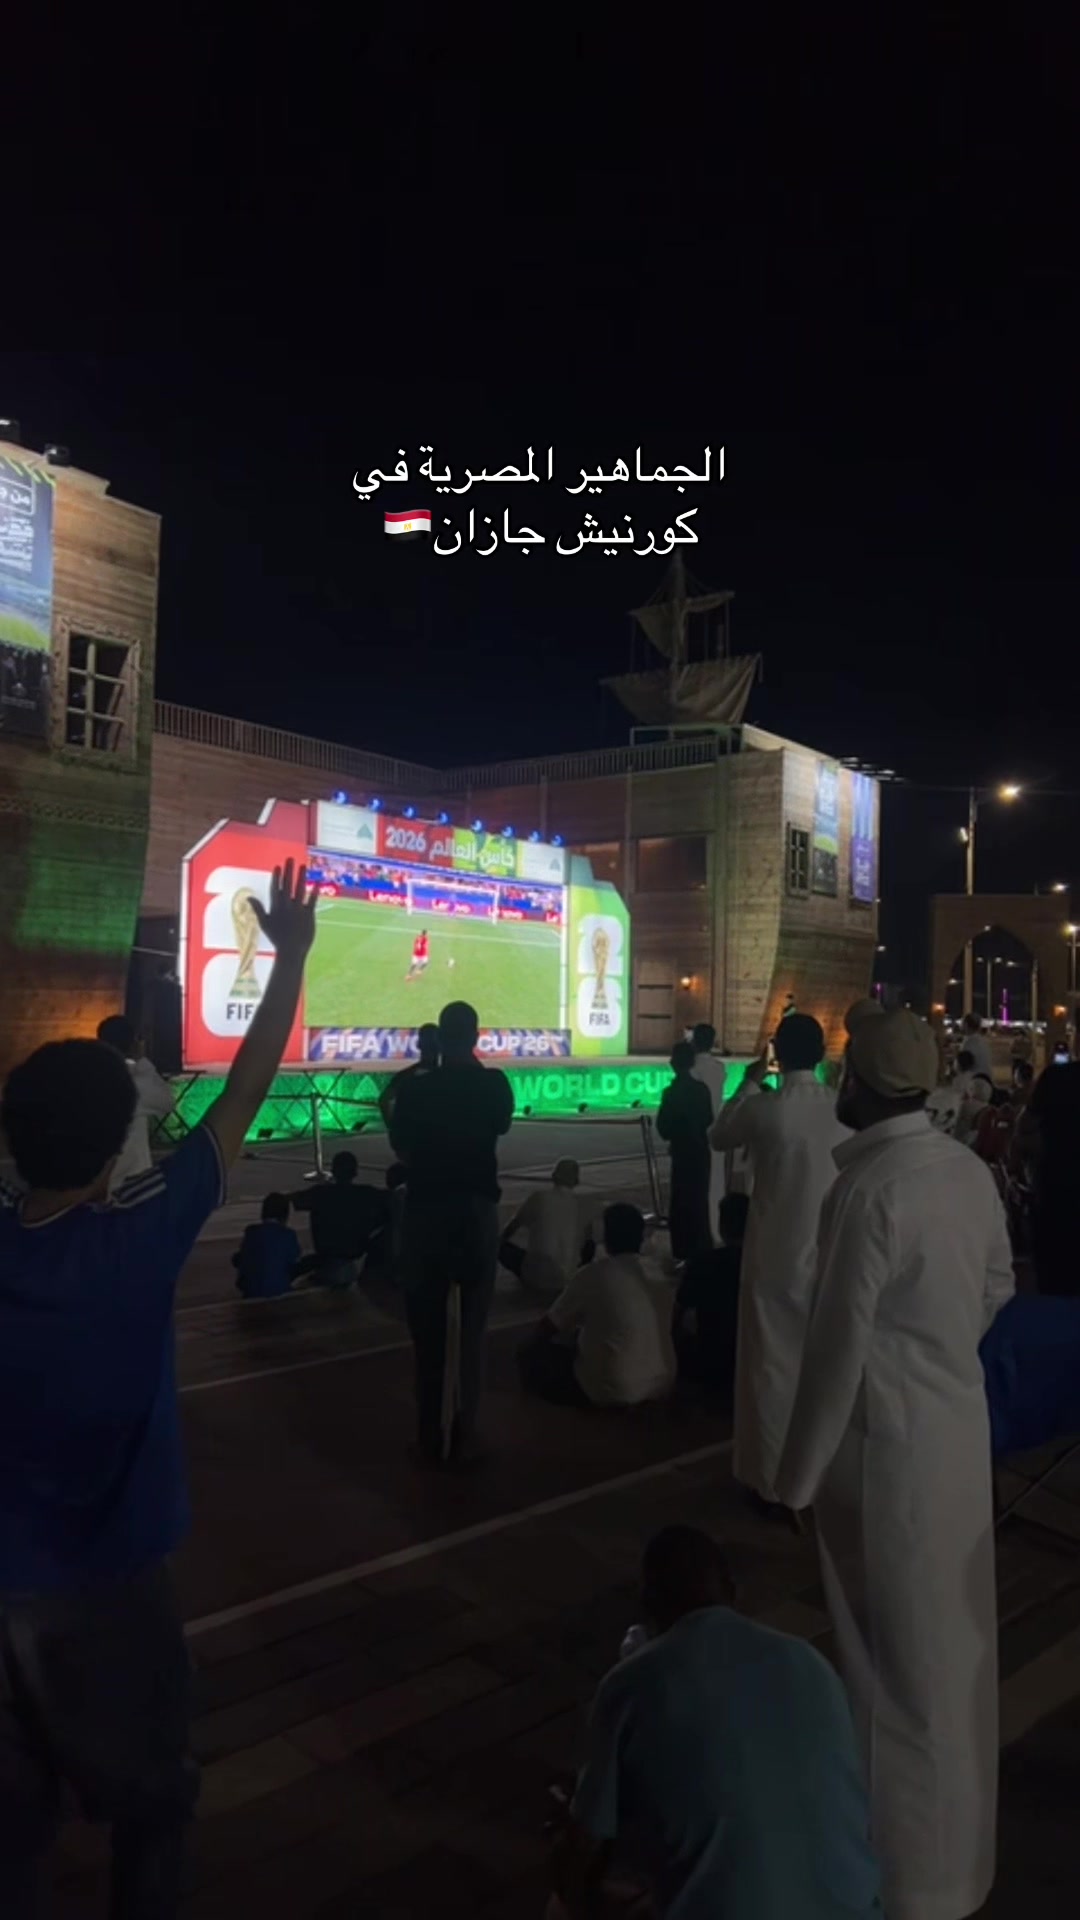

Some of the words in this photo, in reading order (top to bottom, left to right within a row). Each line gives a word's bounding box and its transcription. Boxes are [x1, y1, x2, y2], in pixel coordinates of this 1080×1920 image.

[385, 826, 427, 853] 2026
[428, 836, 477, 862] العالم
[226, 1003, 255, 1021] FIF
[589, 1012, 610, 1026] FIFA
[321, 1034, 382, 1054] FIFA
[477, 1034, 521, 1052] CUP
[513, 1072, 621, 1100] WORLD
